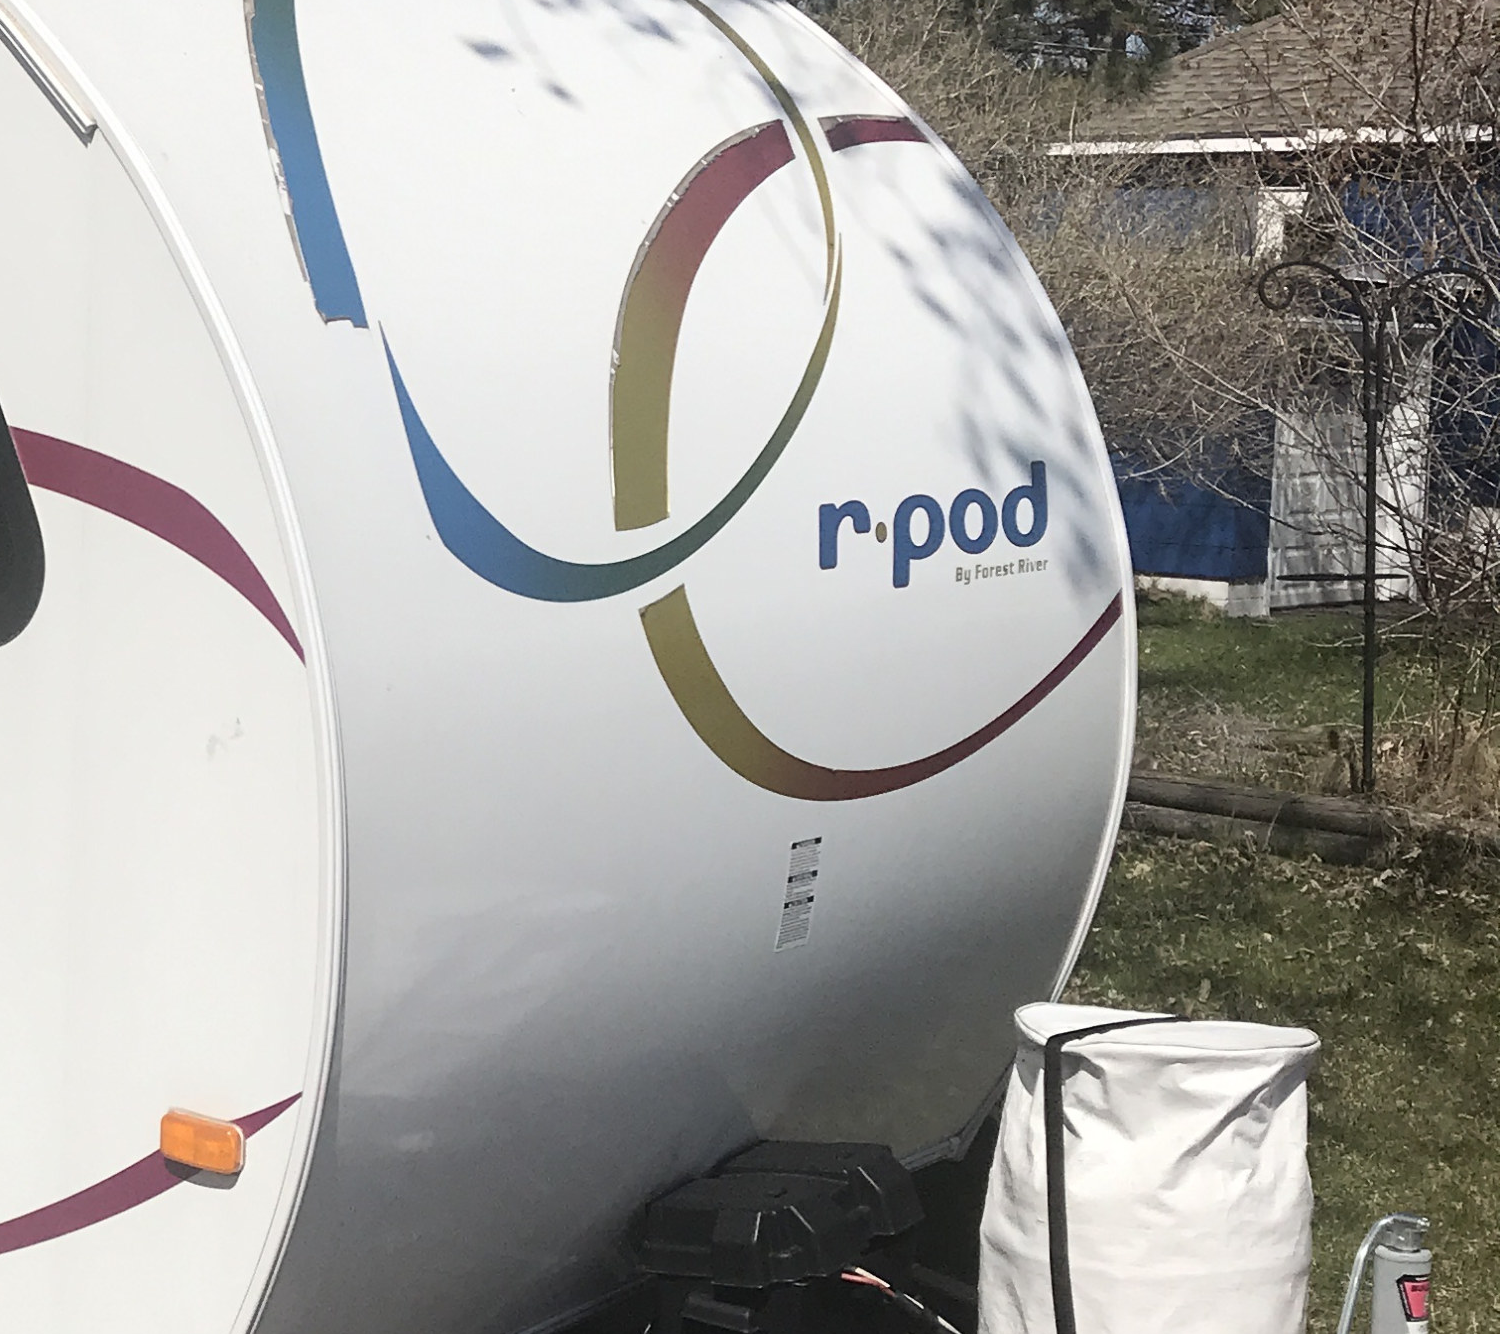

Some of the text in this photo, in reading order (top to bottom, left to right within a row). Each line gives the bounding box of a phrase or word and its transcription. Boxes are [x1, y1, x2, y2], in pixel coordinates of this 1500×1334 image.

[955, 558, 1049, 586] By Forest River
